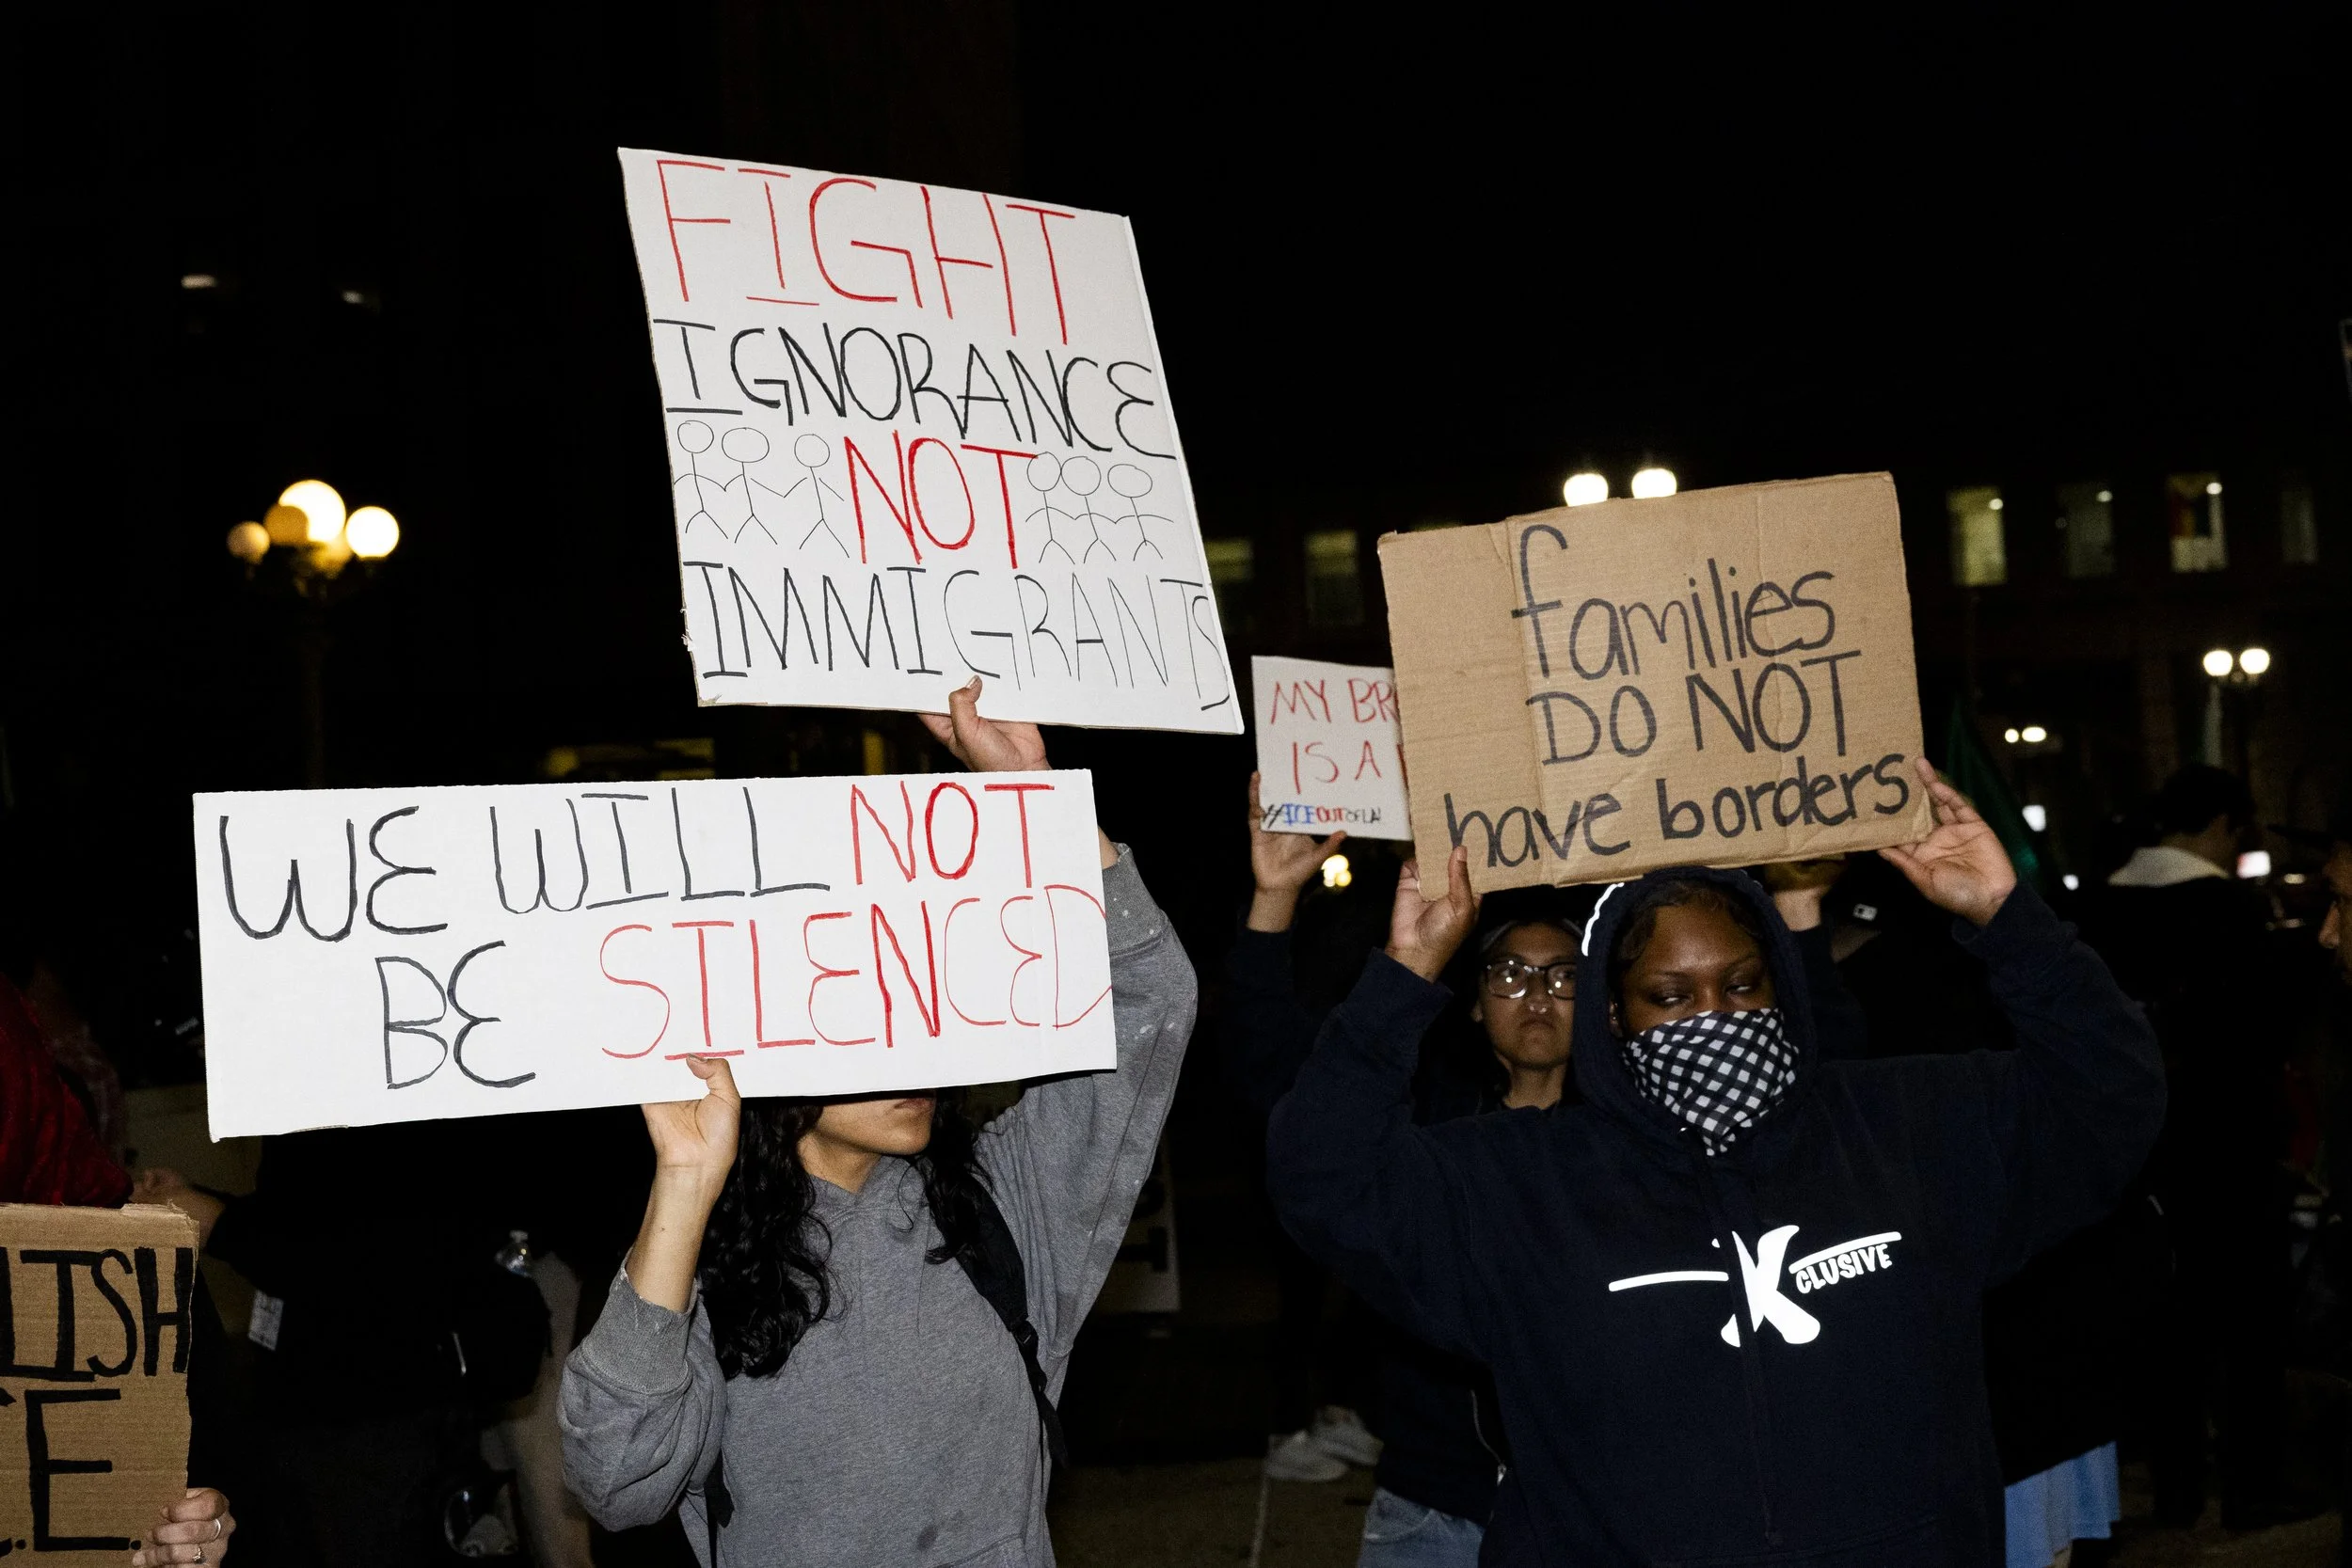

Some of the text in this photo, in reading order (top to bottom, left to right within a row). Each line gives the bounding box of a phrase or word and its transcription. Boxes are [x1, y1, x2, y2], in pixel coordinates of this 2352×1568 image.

[656, 159, 1075, 345] FIGHT
[652, 319, 1177, 461] IGNORANCE
[843, 429, 1040, 570] NOT
[682, 561, 1232, 712] IMMIGRANTS
[1510, 523, 1836, 681] families
[1270, 678, 1332, 725] MY
[1292, 740, 1341, 796] IS
[1354, 739, 1382, 782] A
[1525, 649, 1862, 767] DO NOT
[218, 780, 1057, 942] WE WILL NOT
[1443, 753, 1911, 868] have borders
[374, 883, 1113, 1090] BE SILENCED
